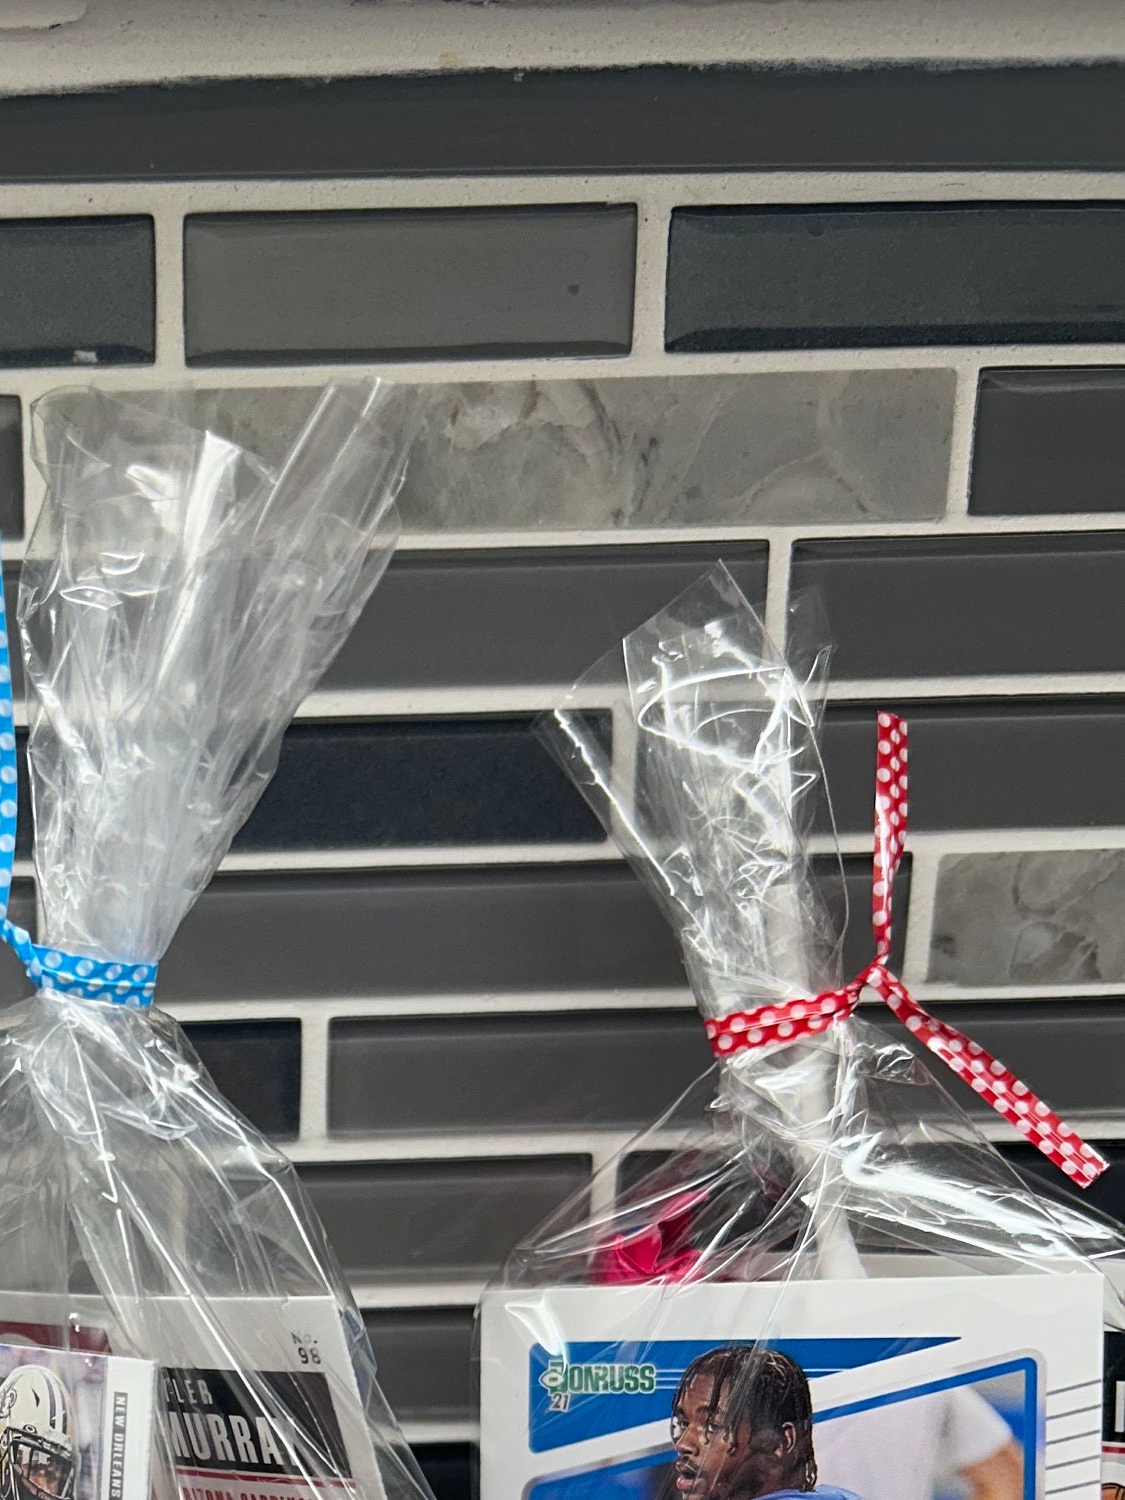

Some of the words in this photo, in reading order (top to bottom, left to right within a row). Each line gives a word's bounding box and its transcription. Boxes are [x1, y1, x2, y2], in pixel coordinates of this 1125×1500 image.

[298, 1347, 321, 1364] 98
[539, 1360, 656, 1394] DONRUSS
[115, 1396, 126, 1427] NEW
[550, 1394, 570, 1412] 21
[168, 1411, 303, 1467] MURRA
[111, 1433, 124, 1498] ORLEANS
